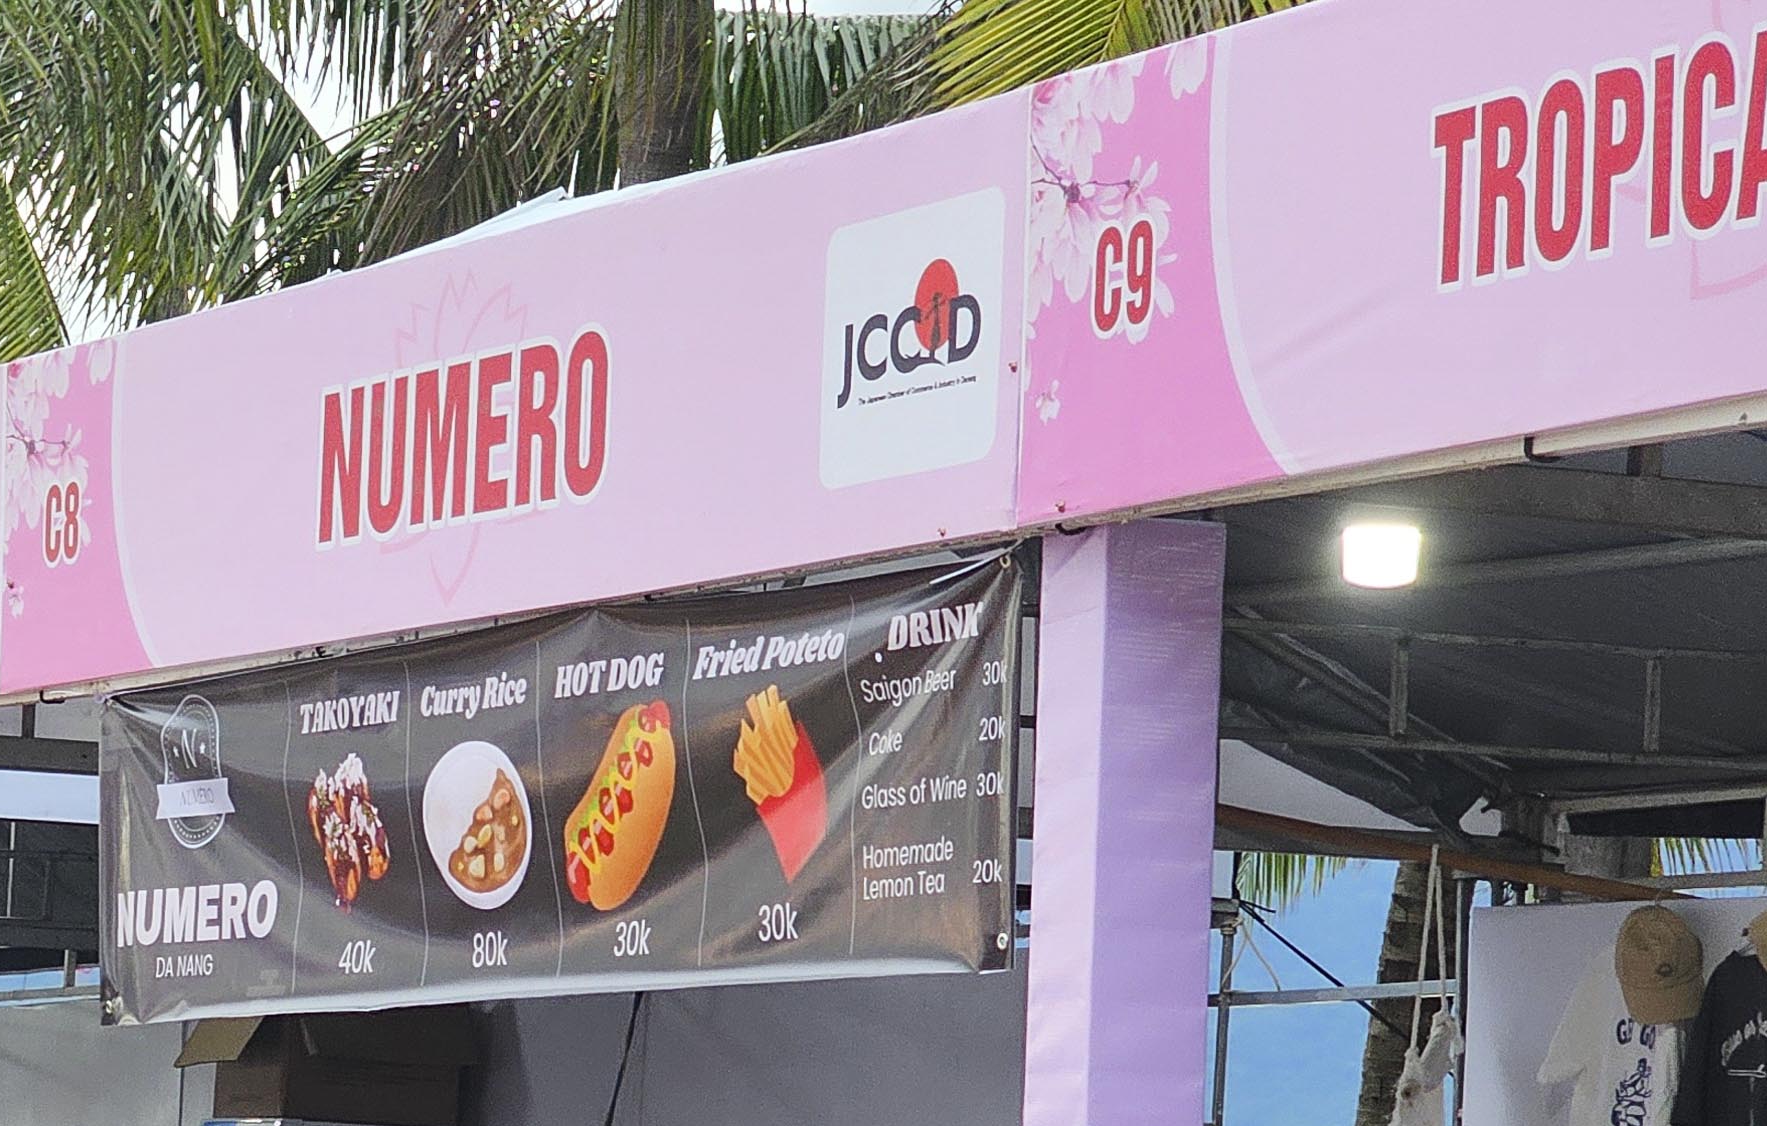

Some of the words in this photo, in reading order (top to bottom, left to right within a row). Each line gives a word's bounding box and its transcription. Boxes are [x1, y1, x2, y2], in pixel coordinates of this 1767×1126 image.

[1095, 224, 1153, 332] C9
[317, 331, 609, 545] NUMERO
[45, 485, 80, 564] C8
[888, 601, 984, 651] DRINK
[554, 660, 606, 699] HOT
[607, 652, 664, 691] DOG
[693, 635, 765, 680] Fried
[762, 629, 845, 670] Poteto
[420, 681, 481, 720] Curry
[482, 671, 527, 709] Rice
[860, 675, 922, 707] Saigon
[924, 670, 956, 694] Beer
[983, 661, 1008, 686] 30k
[300, 690, 400, 735] TAKOYAKI
[869, 729, 903, 755] Coke
[979, 716, 1006, 741] 20k
[862, 784, 906, 809] Glass
[910, 777, 926, 804] of
[930, 775, 967, 802] Wine
[976, 771, 1005, 797] 30k
[863, 836, 954, 869] Homemade
[863, 876, 914, 900] Lemon
[917, 870, 945, 894] Tea
[972, 858, 1003, 884] 20k
[117, 879, 278, 947] NUMERO
[758, 902, 798, 942] 30k
[338, 940, 376, 974] 40k
[472, 931, 508, 968] 80k
[613, 919, 651, 957] 30k
[156, 957, 174, 978] DA
[177, 954, 214, 977] NANG
